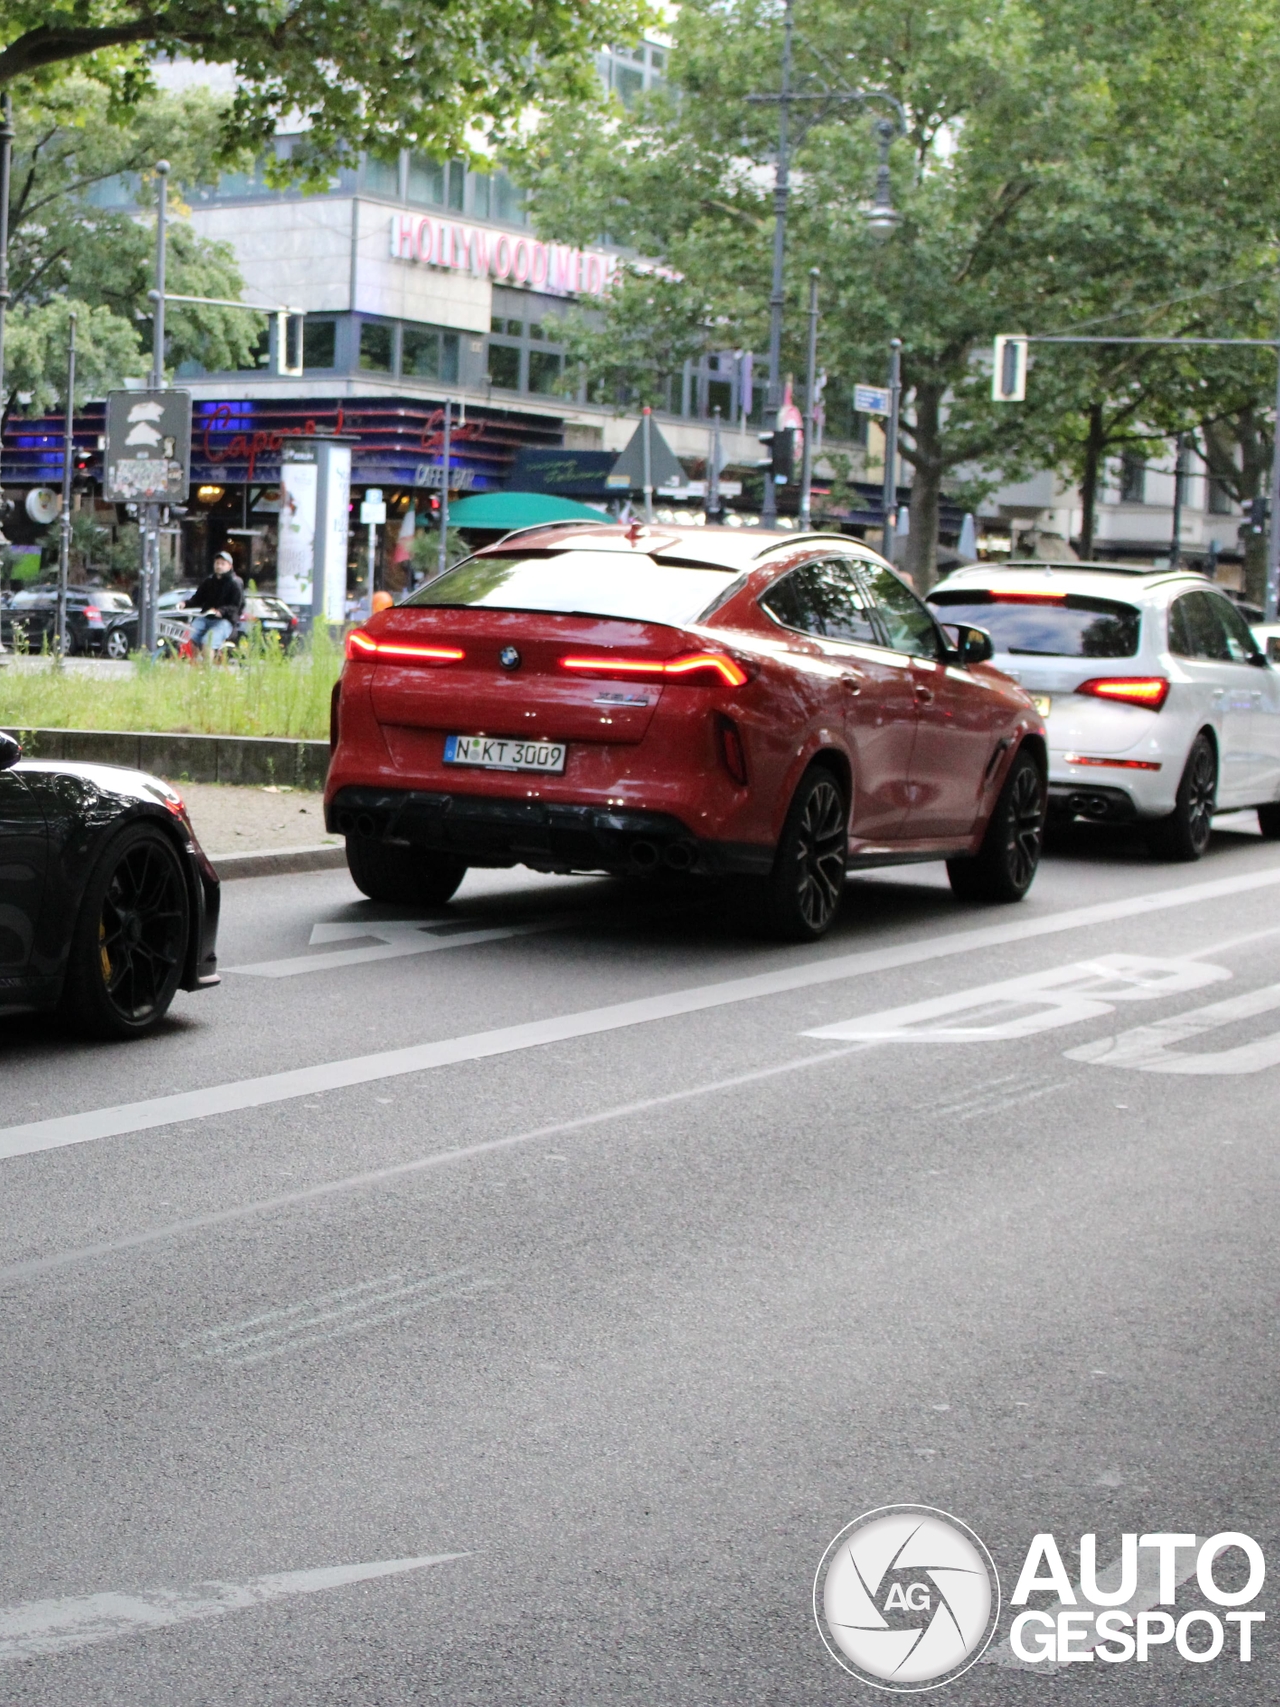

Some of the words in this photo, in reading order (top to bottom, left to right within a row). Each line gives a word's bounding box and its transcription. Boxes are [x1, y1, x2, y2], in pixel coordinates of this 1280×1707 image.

[391, 215, 548, 285] HOLLYWOOD
[456, 739, 470, 759] N
[482, 741, 508, 762] KT
[512, 743, 562, 767] 3009
